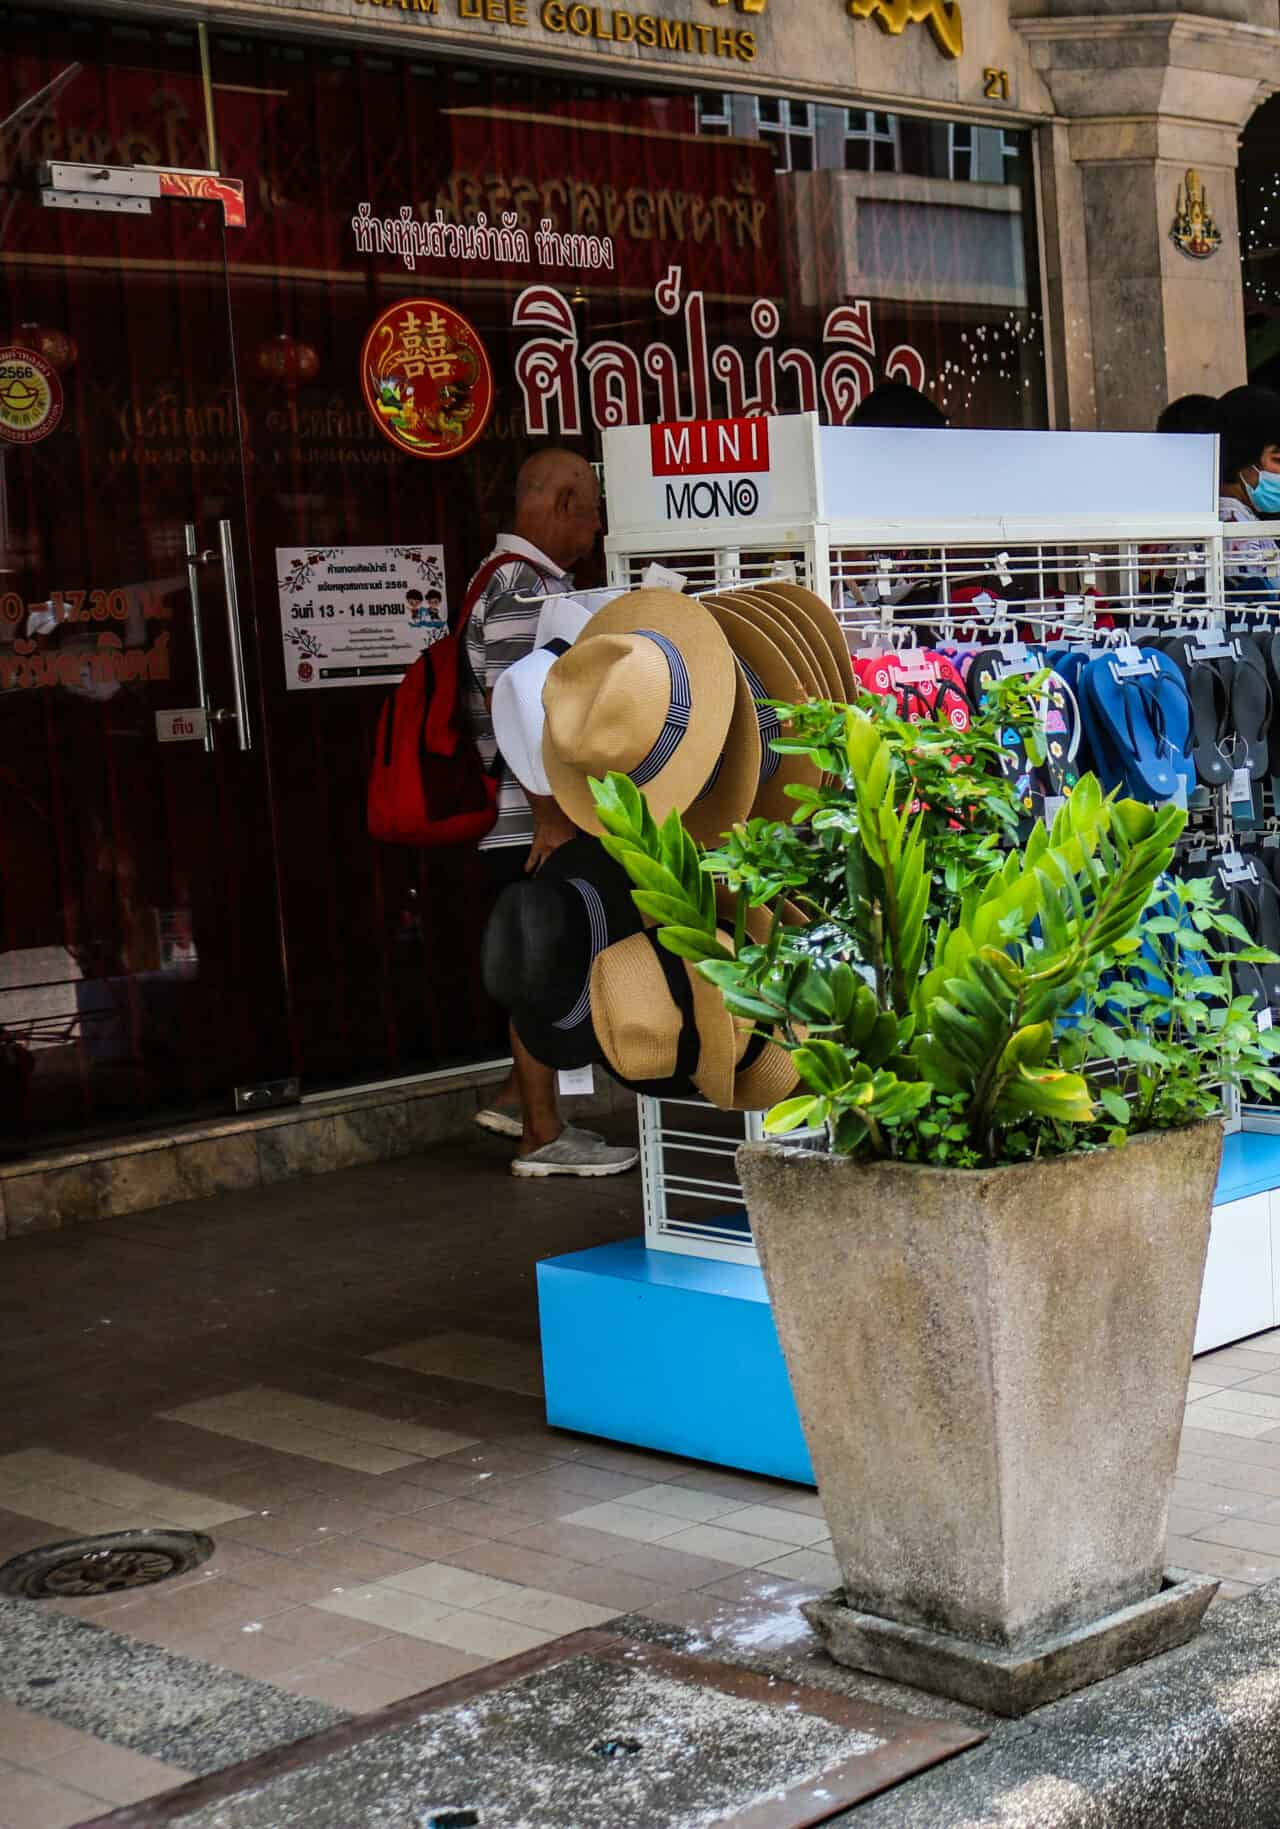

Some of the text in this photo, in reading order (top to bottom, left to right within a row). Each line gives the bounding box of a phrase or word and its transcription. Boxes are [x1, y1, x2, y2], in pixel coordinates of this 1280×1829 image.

[540, 0, 758, 63] GOLDSMITHS
[984, 68, 1010, 99] 21
[352, 202, 615, 271] ห้างหุ้นส่วนจำกัด ห้างทอง
[663, 422, 759, 466] MINI
[665, 478, 759, 520] MONO
[50, 589, 129, 623] 17.30
[290, 600, 315, 620] วันที่
[319, 604, 335, 619] 13
[350, 603, 365, 618] 14
